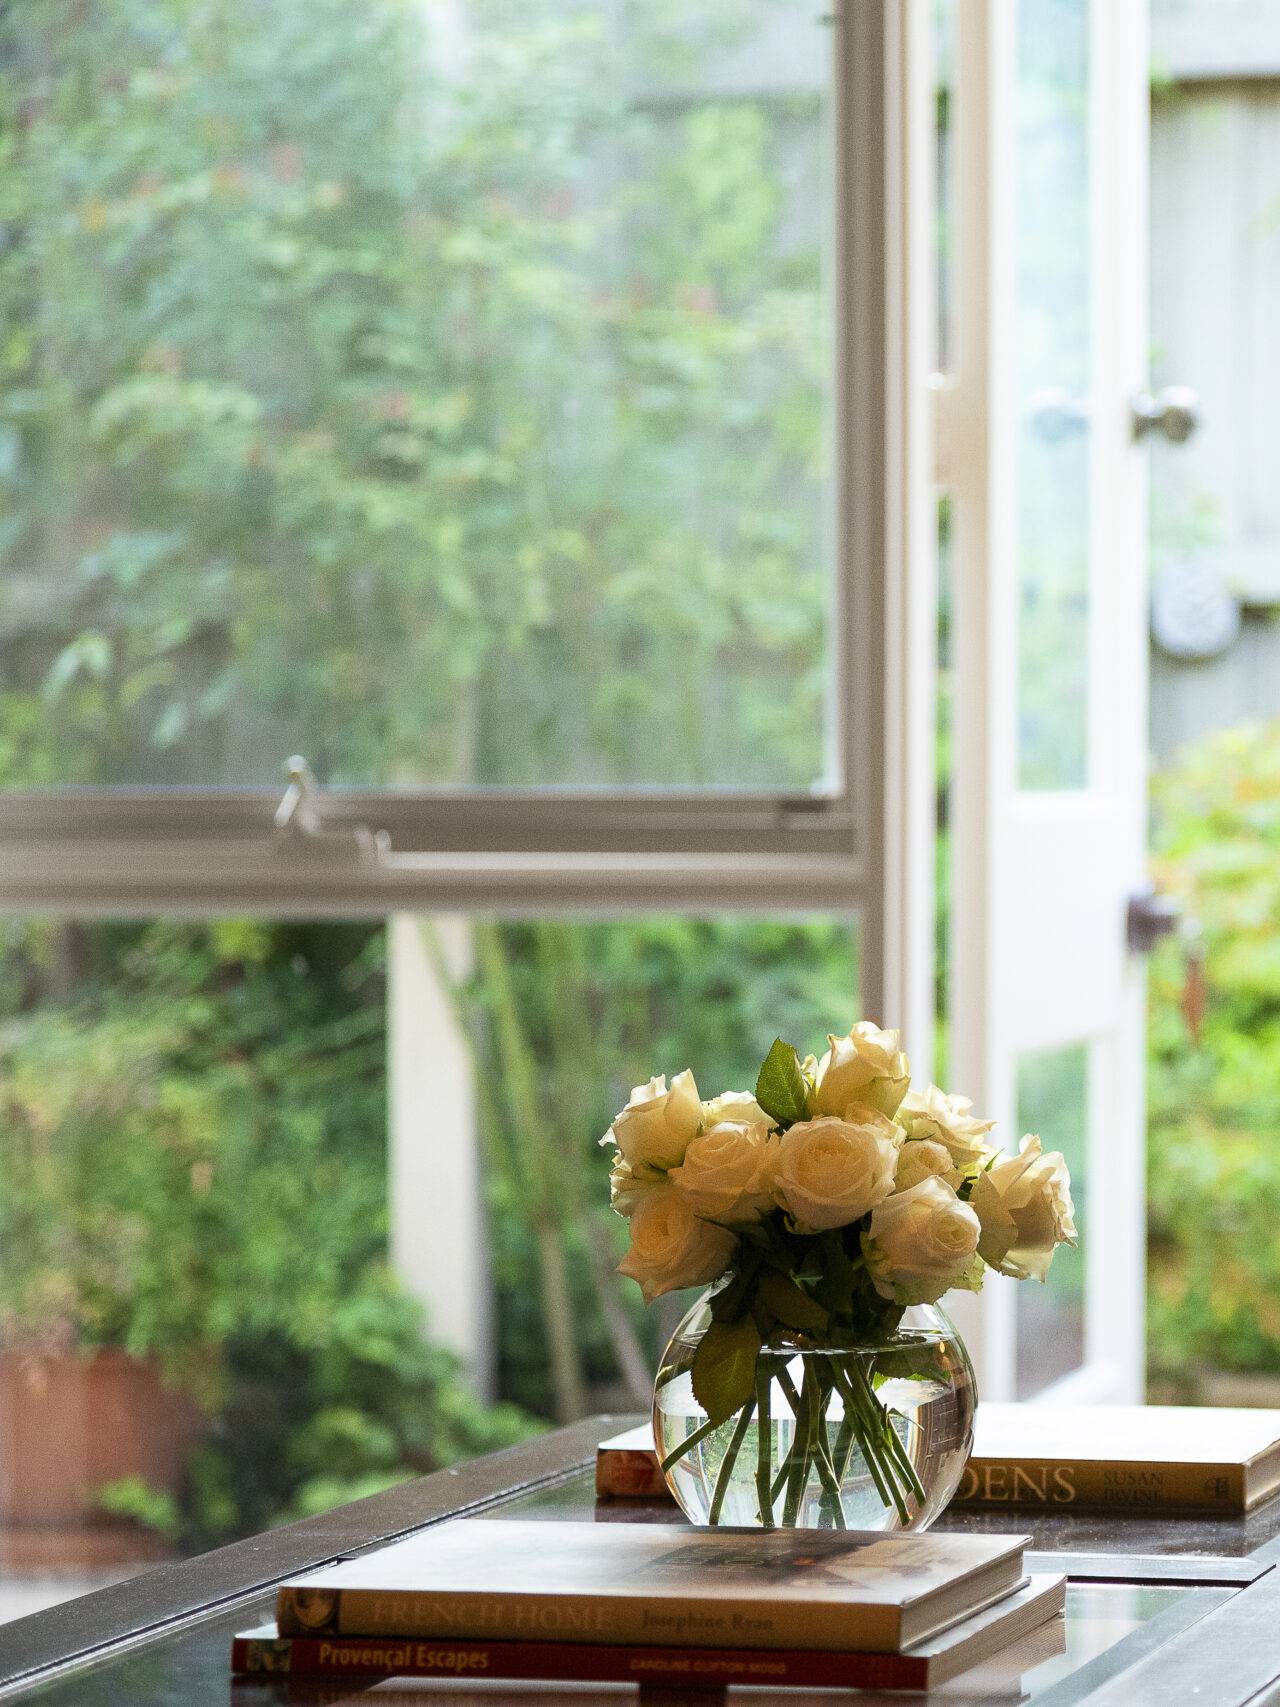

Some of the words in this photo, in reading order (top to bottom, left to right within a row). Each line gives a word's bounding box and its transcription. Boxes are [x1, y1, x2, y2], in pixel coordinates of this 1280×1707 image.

[1104, 1472, 1164, 1486] SUSAN
[1104, 1487, 1163, 1501] IRVINE
[374, 1600, 500, 1626] FRENCH
[515, 1605, 613, 1630] HOME
[641, 1609, 724, 1632] Josephine
[732, 1613, 773, 1632] Ryan
[318, 1643, 411, 1672] Provençal
[416, 1645, 489, 1673] Escapes
[630, 1659, 690, 1672] CAROLINE
